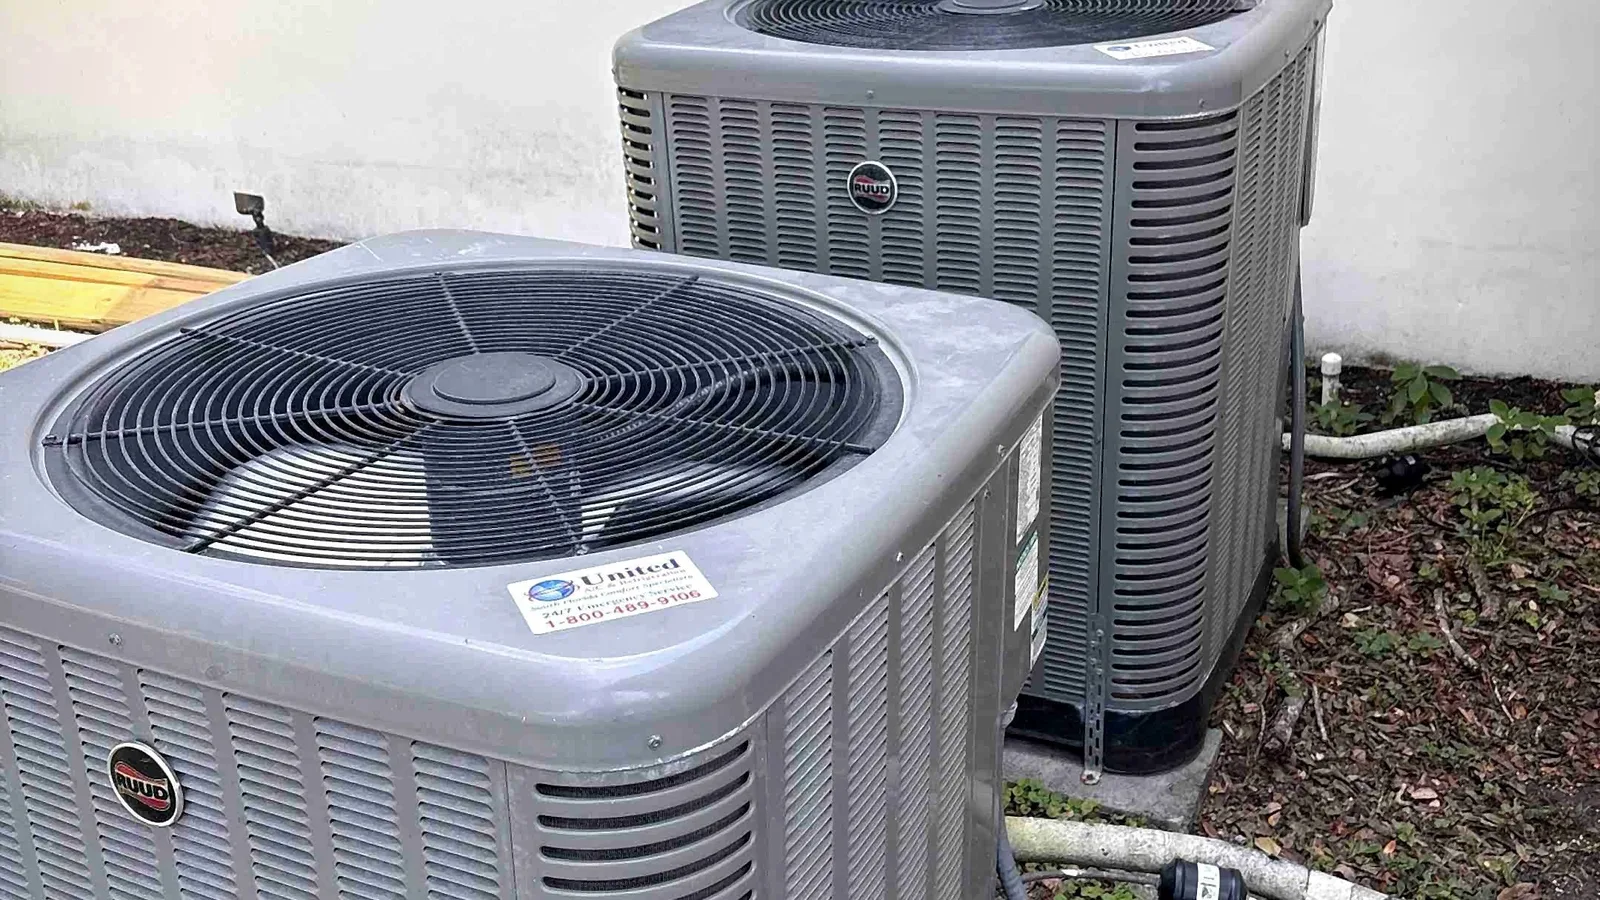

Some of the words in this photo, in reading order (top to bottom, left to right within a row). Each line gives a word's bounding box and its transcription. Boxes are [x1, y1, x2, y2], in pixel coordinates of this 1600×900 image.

[854, 183, 890, 194] RUUD
[580, 558, 681, 586] United
[541, 607, 572, 620] 24/7
[576, 593, 646, 612] Emergency
[648, 584, 693, 597] Service
[600, 585, 640, 599] Comfort
[545, 589, 702, 629] 1-800-489-9106
[115, 772, 169, 801] RUUD
